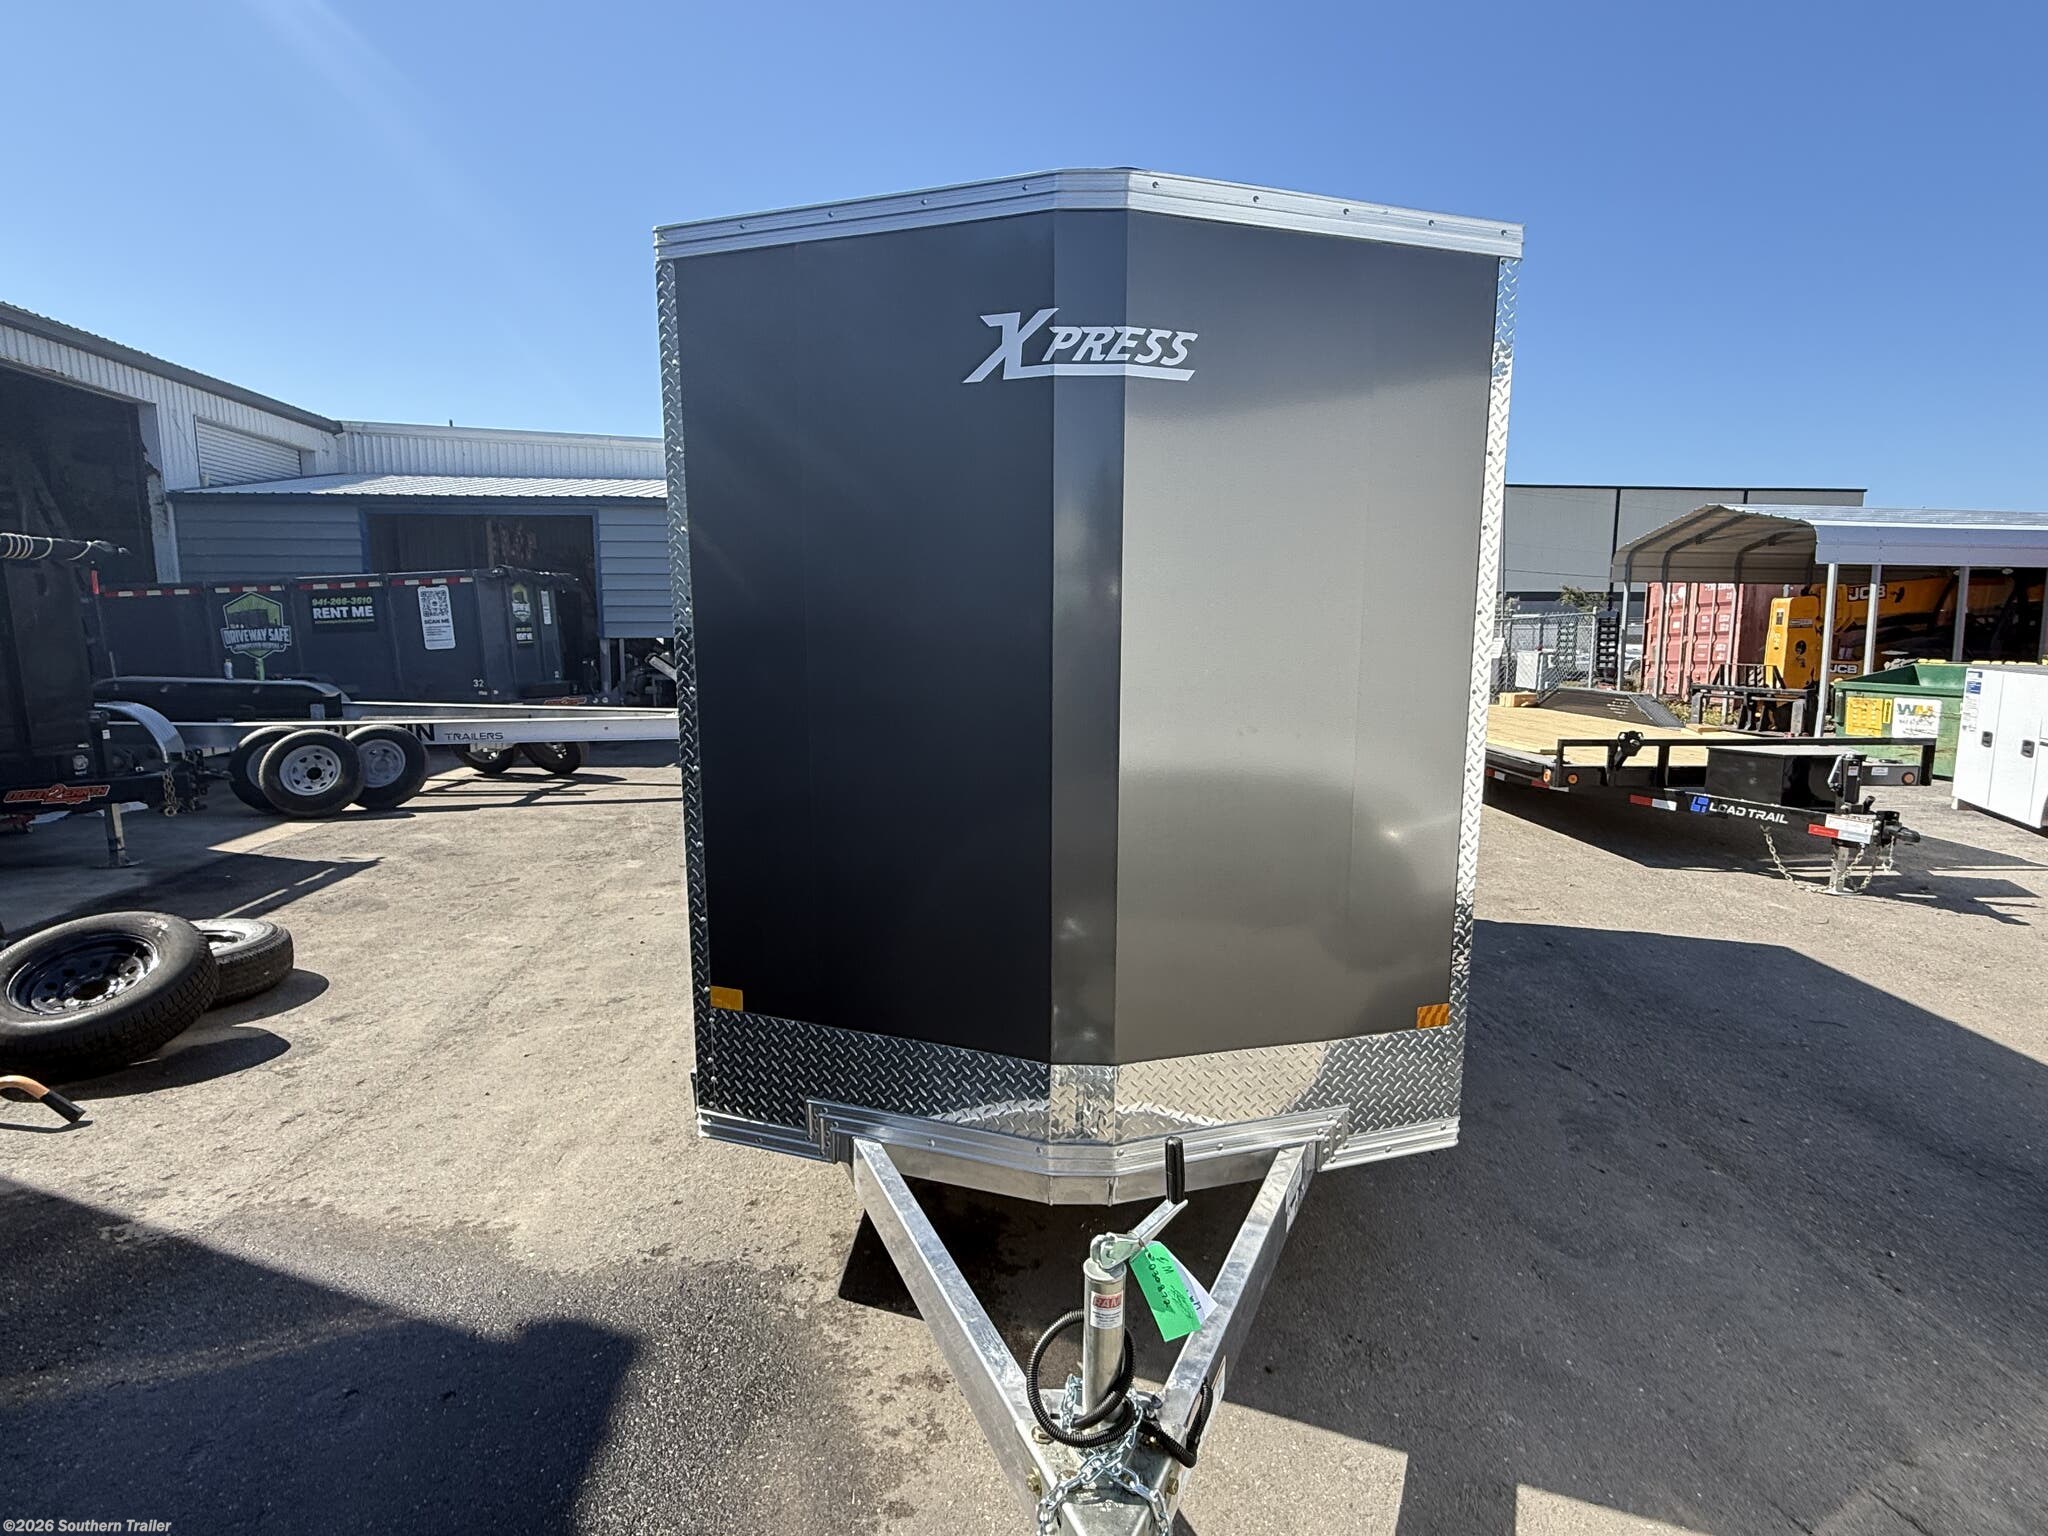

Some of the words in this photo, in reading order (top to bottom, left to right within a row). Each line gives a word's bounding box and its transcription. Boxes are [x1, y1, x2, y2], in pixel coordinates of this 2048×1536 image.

[962, 307, 1199, 384] XPRESS
[1848, 587, 1886, 601] JCB
[312, 606, 348, 619] RENT
[351, 605, 375, 618] ME
[223, 628, 268, 646] DRIVEWAY
[268, 626, 290, 643] SAFE
[1829, 664, 1858, 674] JCB
[473, 679, 485, 688] 32
[444, 731, 504, 741] TRAILERS
[1709, 802, 1746, 818] LOAD
[1747, 808, 1789, 825] TRAIL
